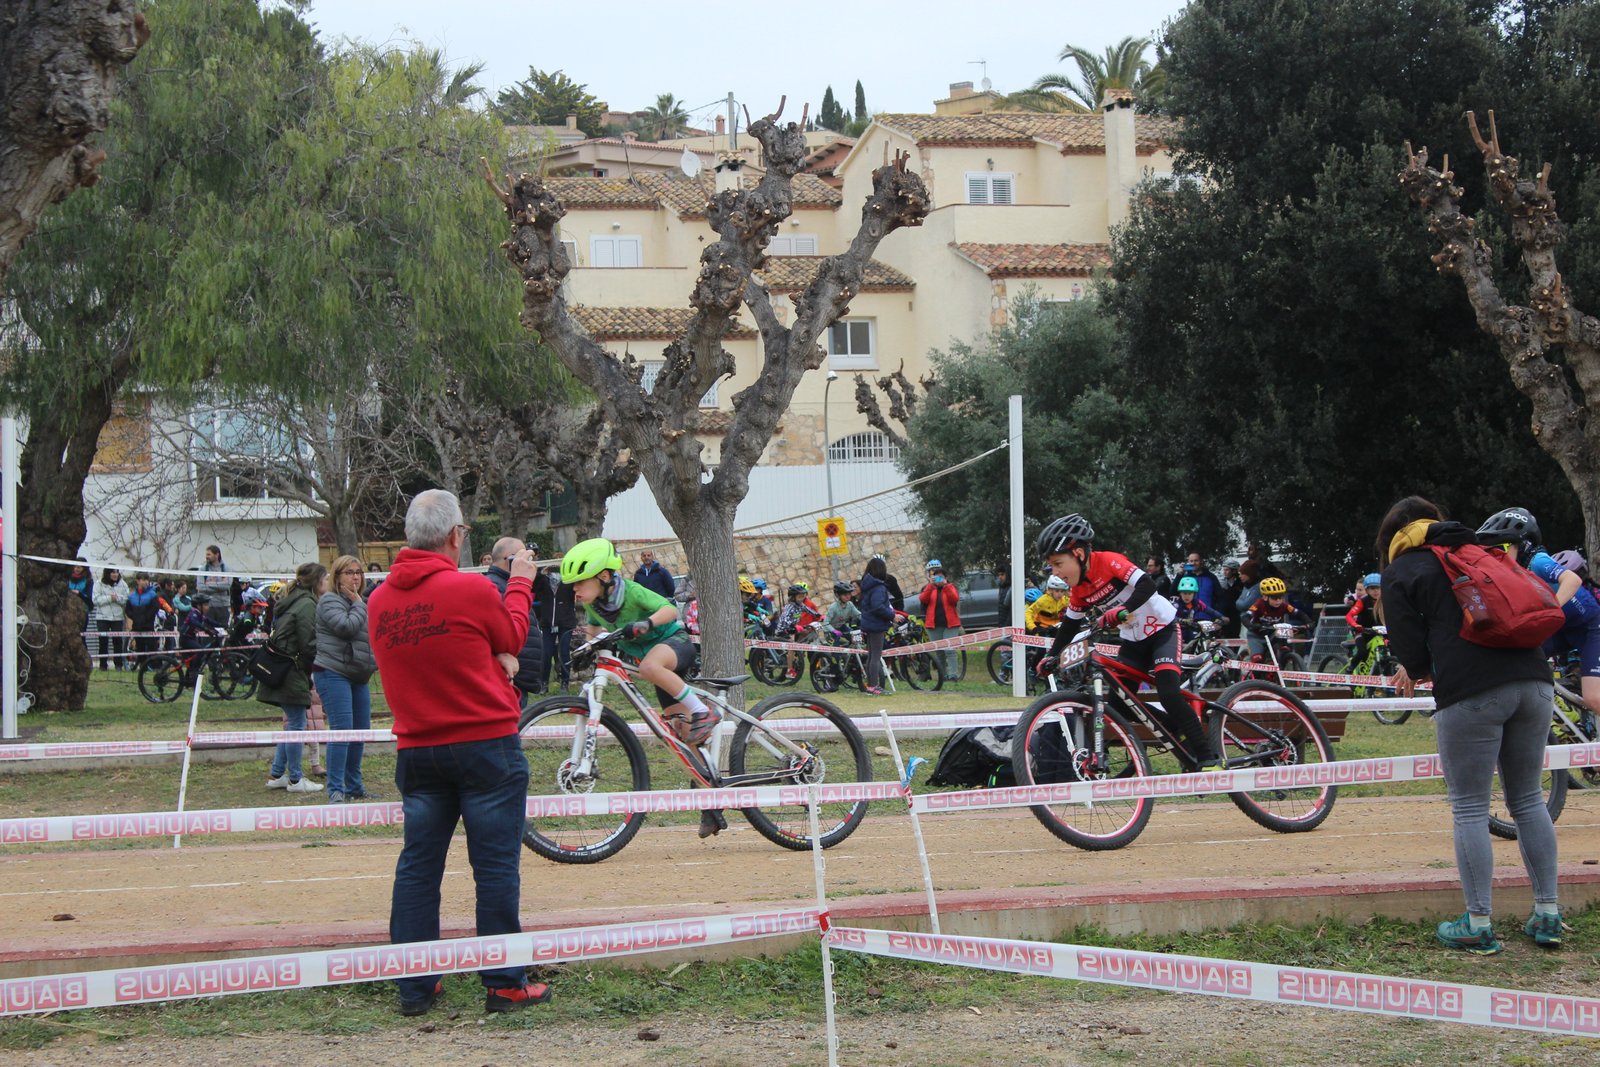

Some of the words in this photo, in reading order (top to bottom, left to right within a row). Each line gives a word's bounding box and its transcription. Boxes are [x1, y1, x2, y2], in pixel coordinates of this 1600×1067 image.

[1505, 512, 1529, 523] POC
[1062, 641, 1085, 664] 383
[1350, 676, 1382, 685] BAUHAUS
[1116, 687, 1175, 750] TREK
